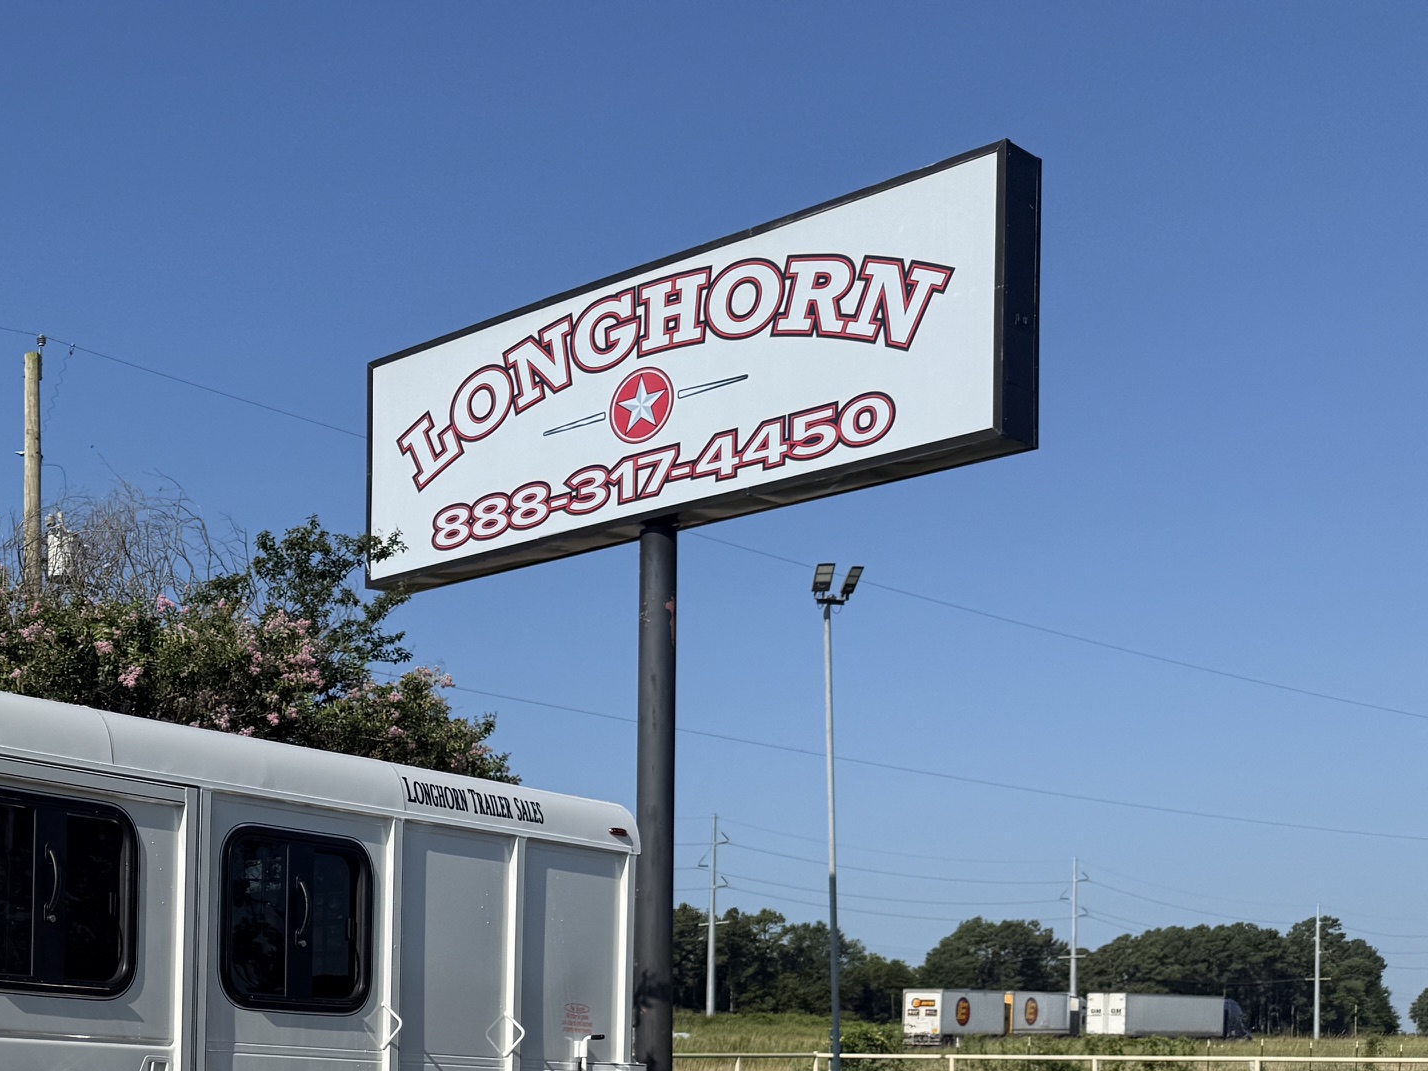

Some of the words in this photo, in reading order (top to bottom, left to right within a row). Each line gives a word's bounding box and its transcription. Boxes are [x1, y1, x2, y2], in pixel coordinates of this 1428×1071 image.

[397, 253, 956, 491] LONGHORN
[431, 391, 897, 551] 888-317-4450
[402, 776, 469, 812] LONGHORN
[467, 788, 514, 819] TRAILER
[513, 797, 544, 824] SALES
